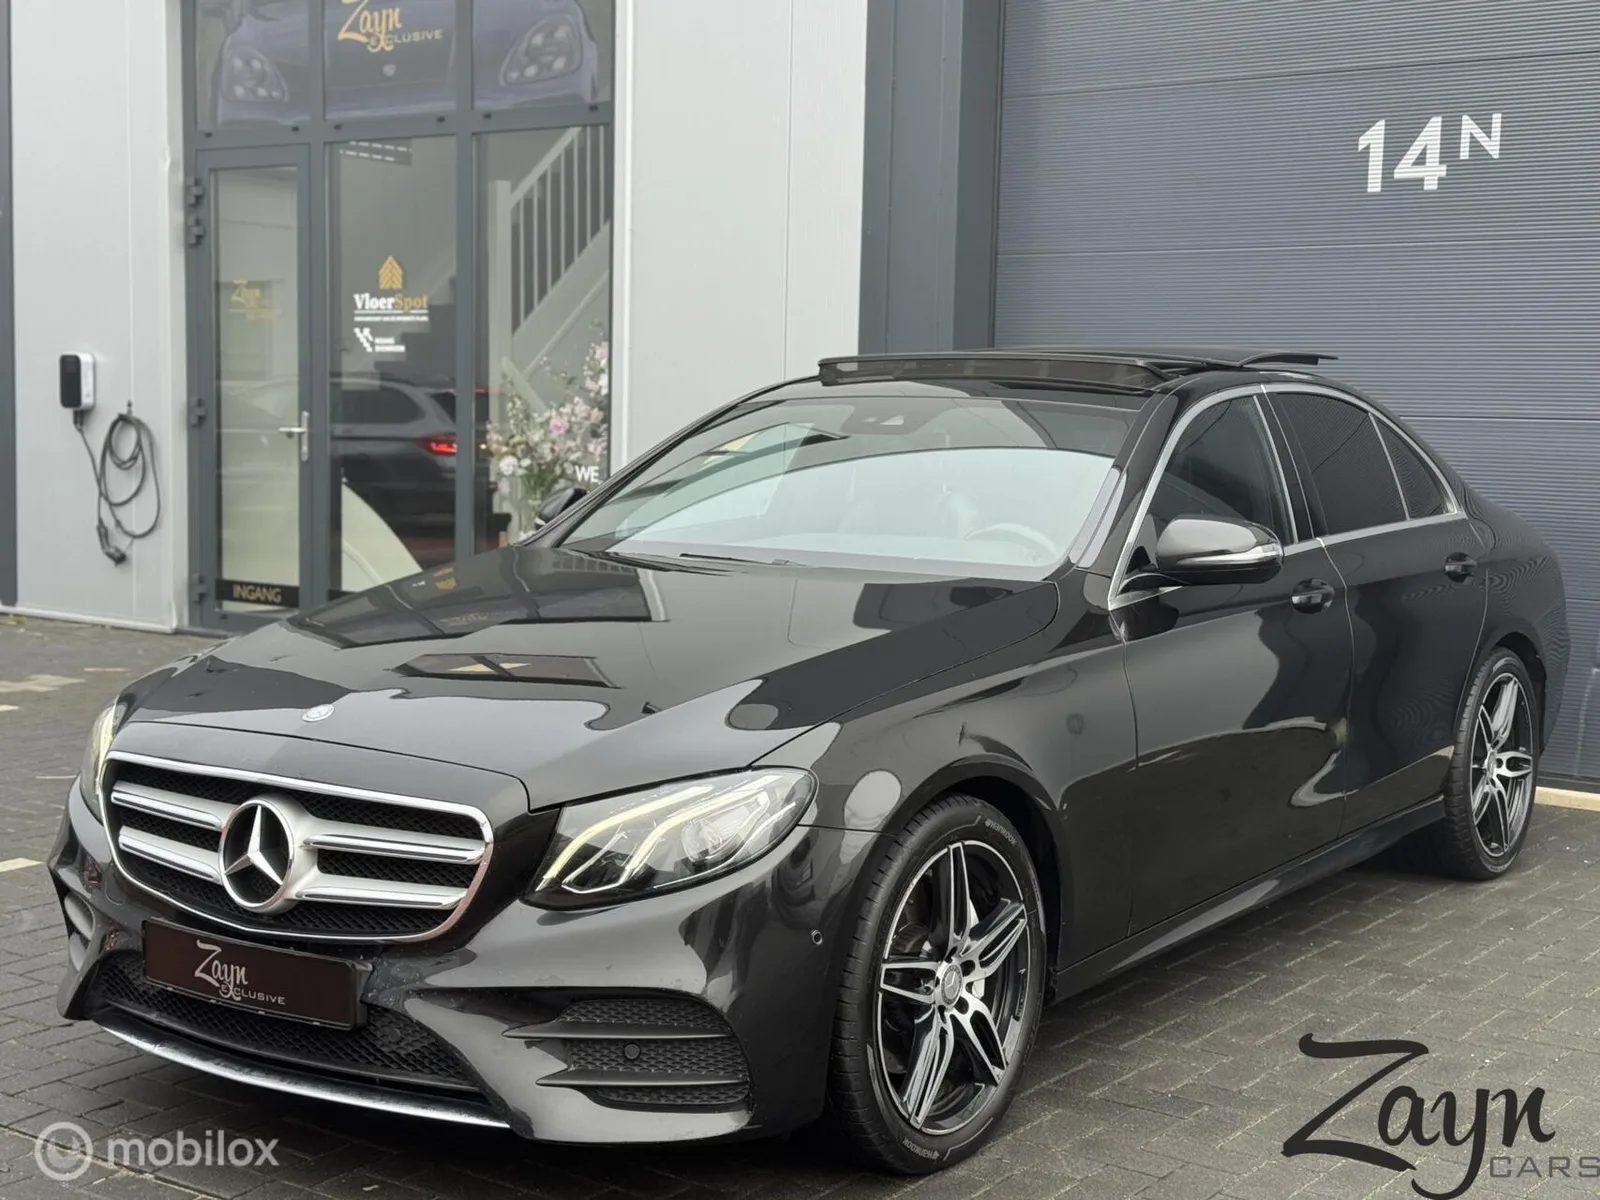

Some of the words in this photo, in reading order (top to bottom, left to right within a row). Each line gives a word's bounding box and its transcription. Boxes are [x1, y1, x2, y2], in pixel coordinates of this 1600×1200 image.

[337, 0, 402, 52] Zayn
[353, 292, 428, 311] VloerSpot
[233, 584, 282, 604] INGANG
[194, 939, 248, 1002] Zayn
